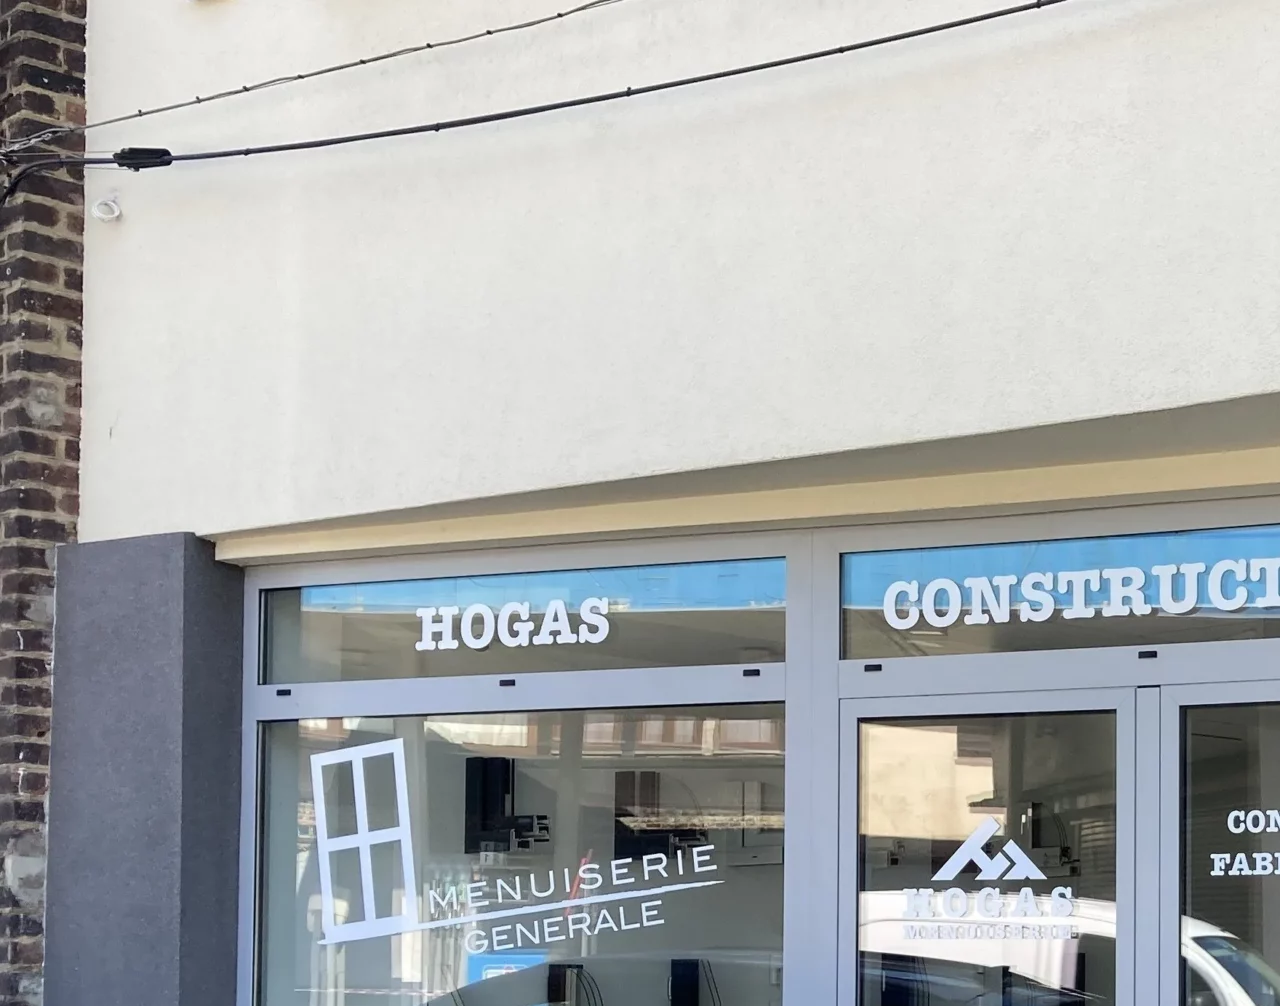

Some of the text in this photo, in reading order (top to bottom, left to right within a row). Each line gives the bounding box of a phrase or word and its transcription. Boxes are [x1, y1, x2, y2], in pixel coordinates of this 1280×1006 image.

[415, 597, 609, 651] HOGAS
[429, 845, 718, 913] MENUISERIE
[902, 886, 1075, 918] HOGAS
[465, 900, 665, 954] GENERALE
